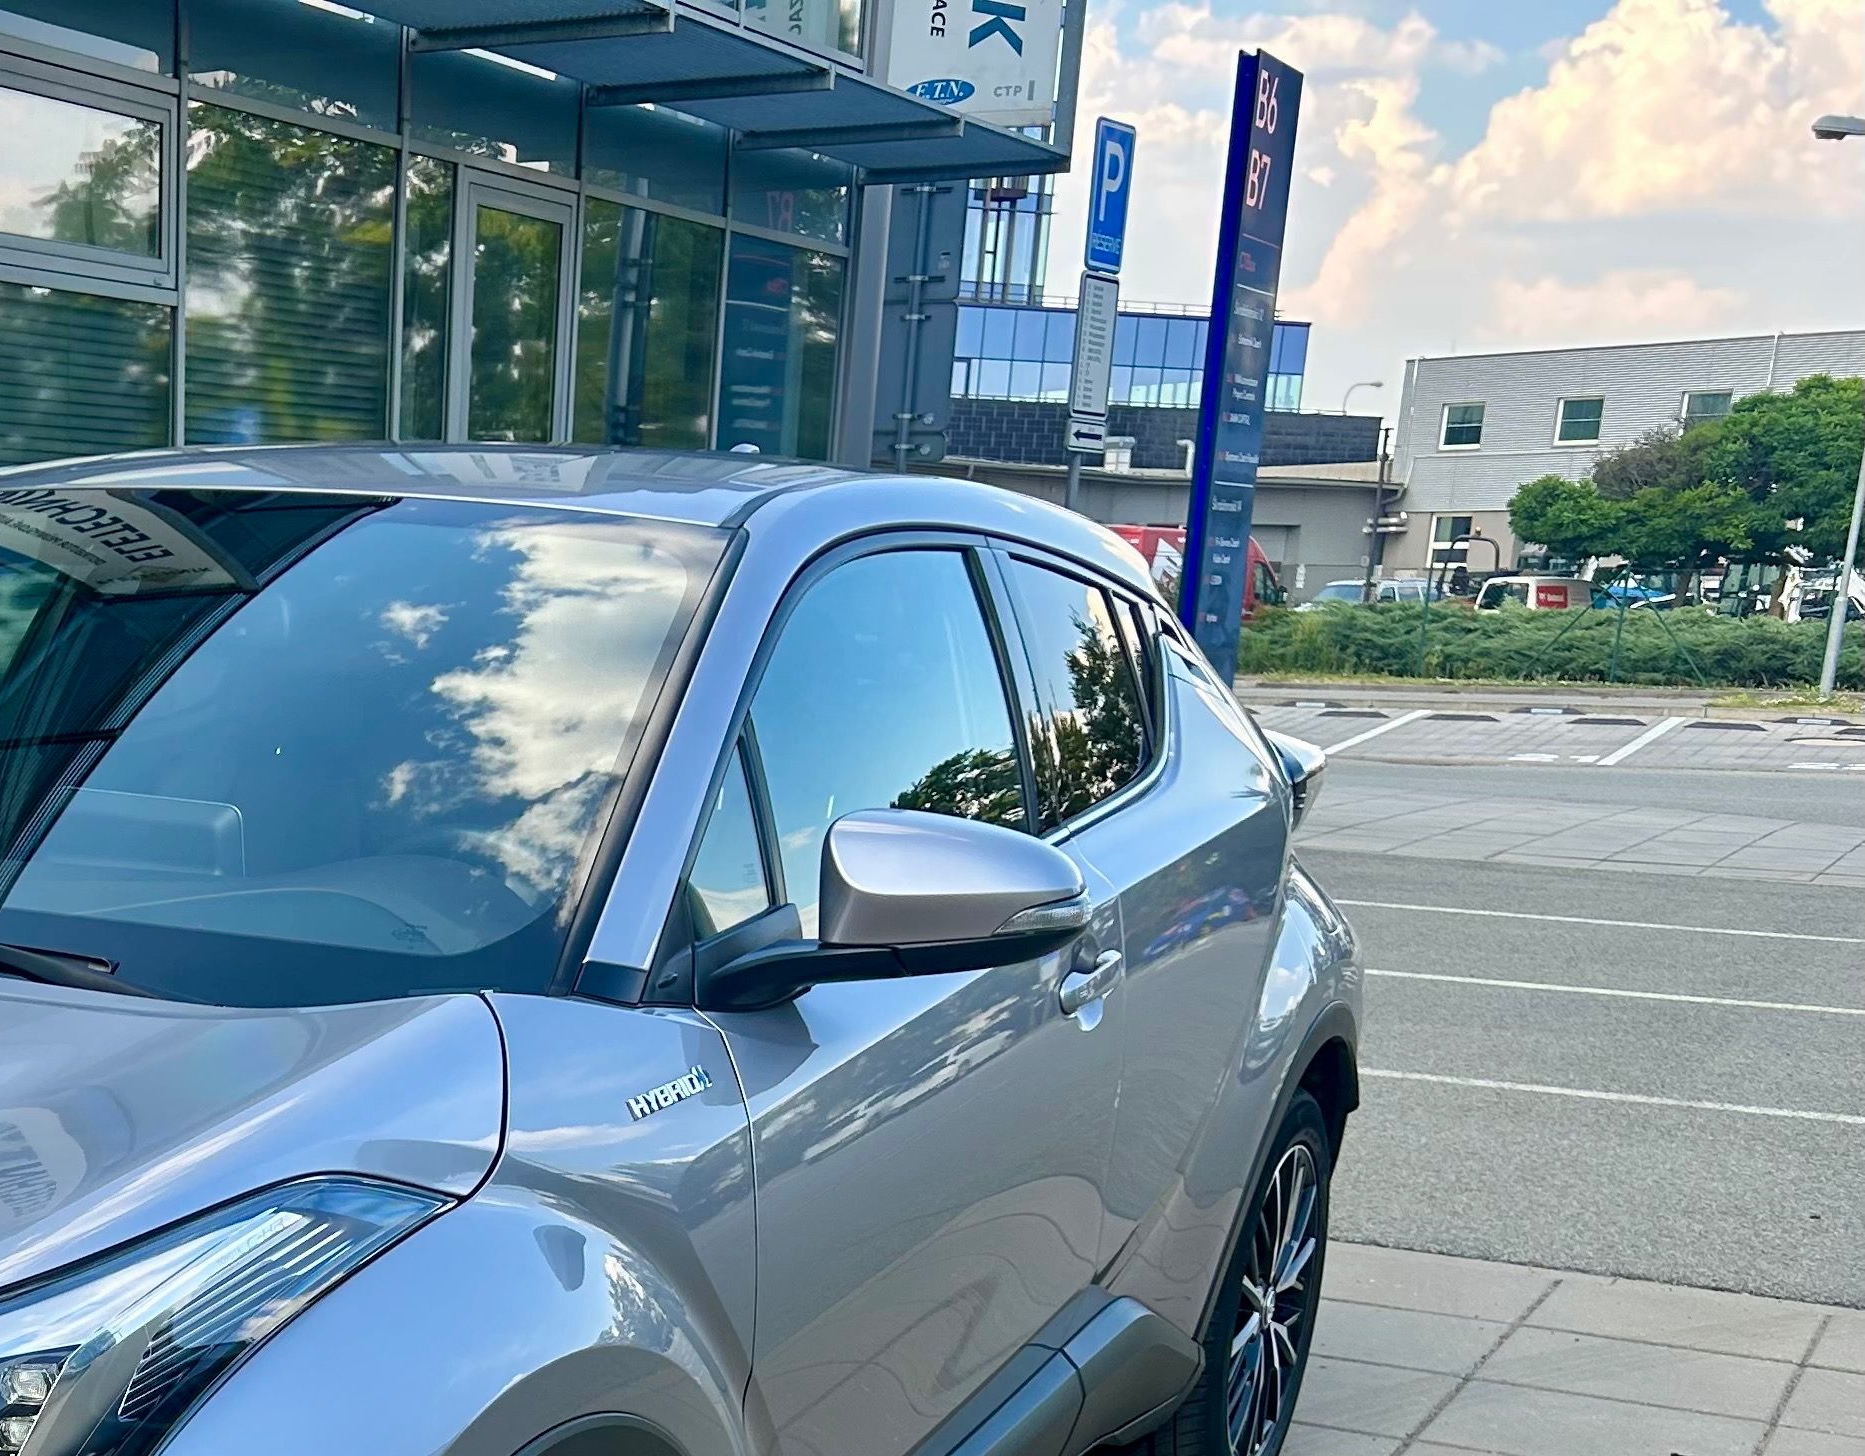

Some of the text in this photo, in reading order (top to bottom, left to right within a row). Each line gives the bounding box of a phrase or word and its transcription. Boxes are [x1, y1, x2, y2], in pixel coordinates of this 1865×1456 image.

[993, 86, 1023, 97] CTP
[1255, 68, 1278, 134] B6
[1098, 140, 1125, 222] P
[1246, 148, 1271, 209] B7
[625, 1072, 706, 1121] HYBRID
